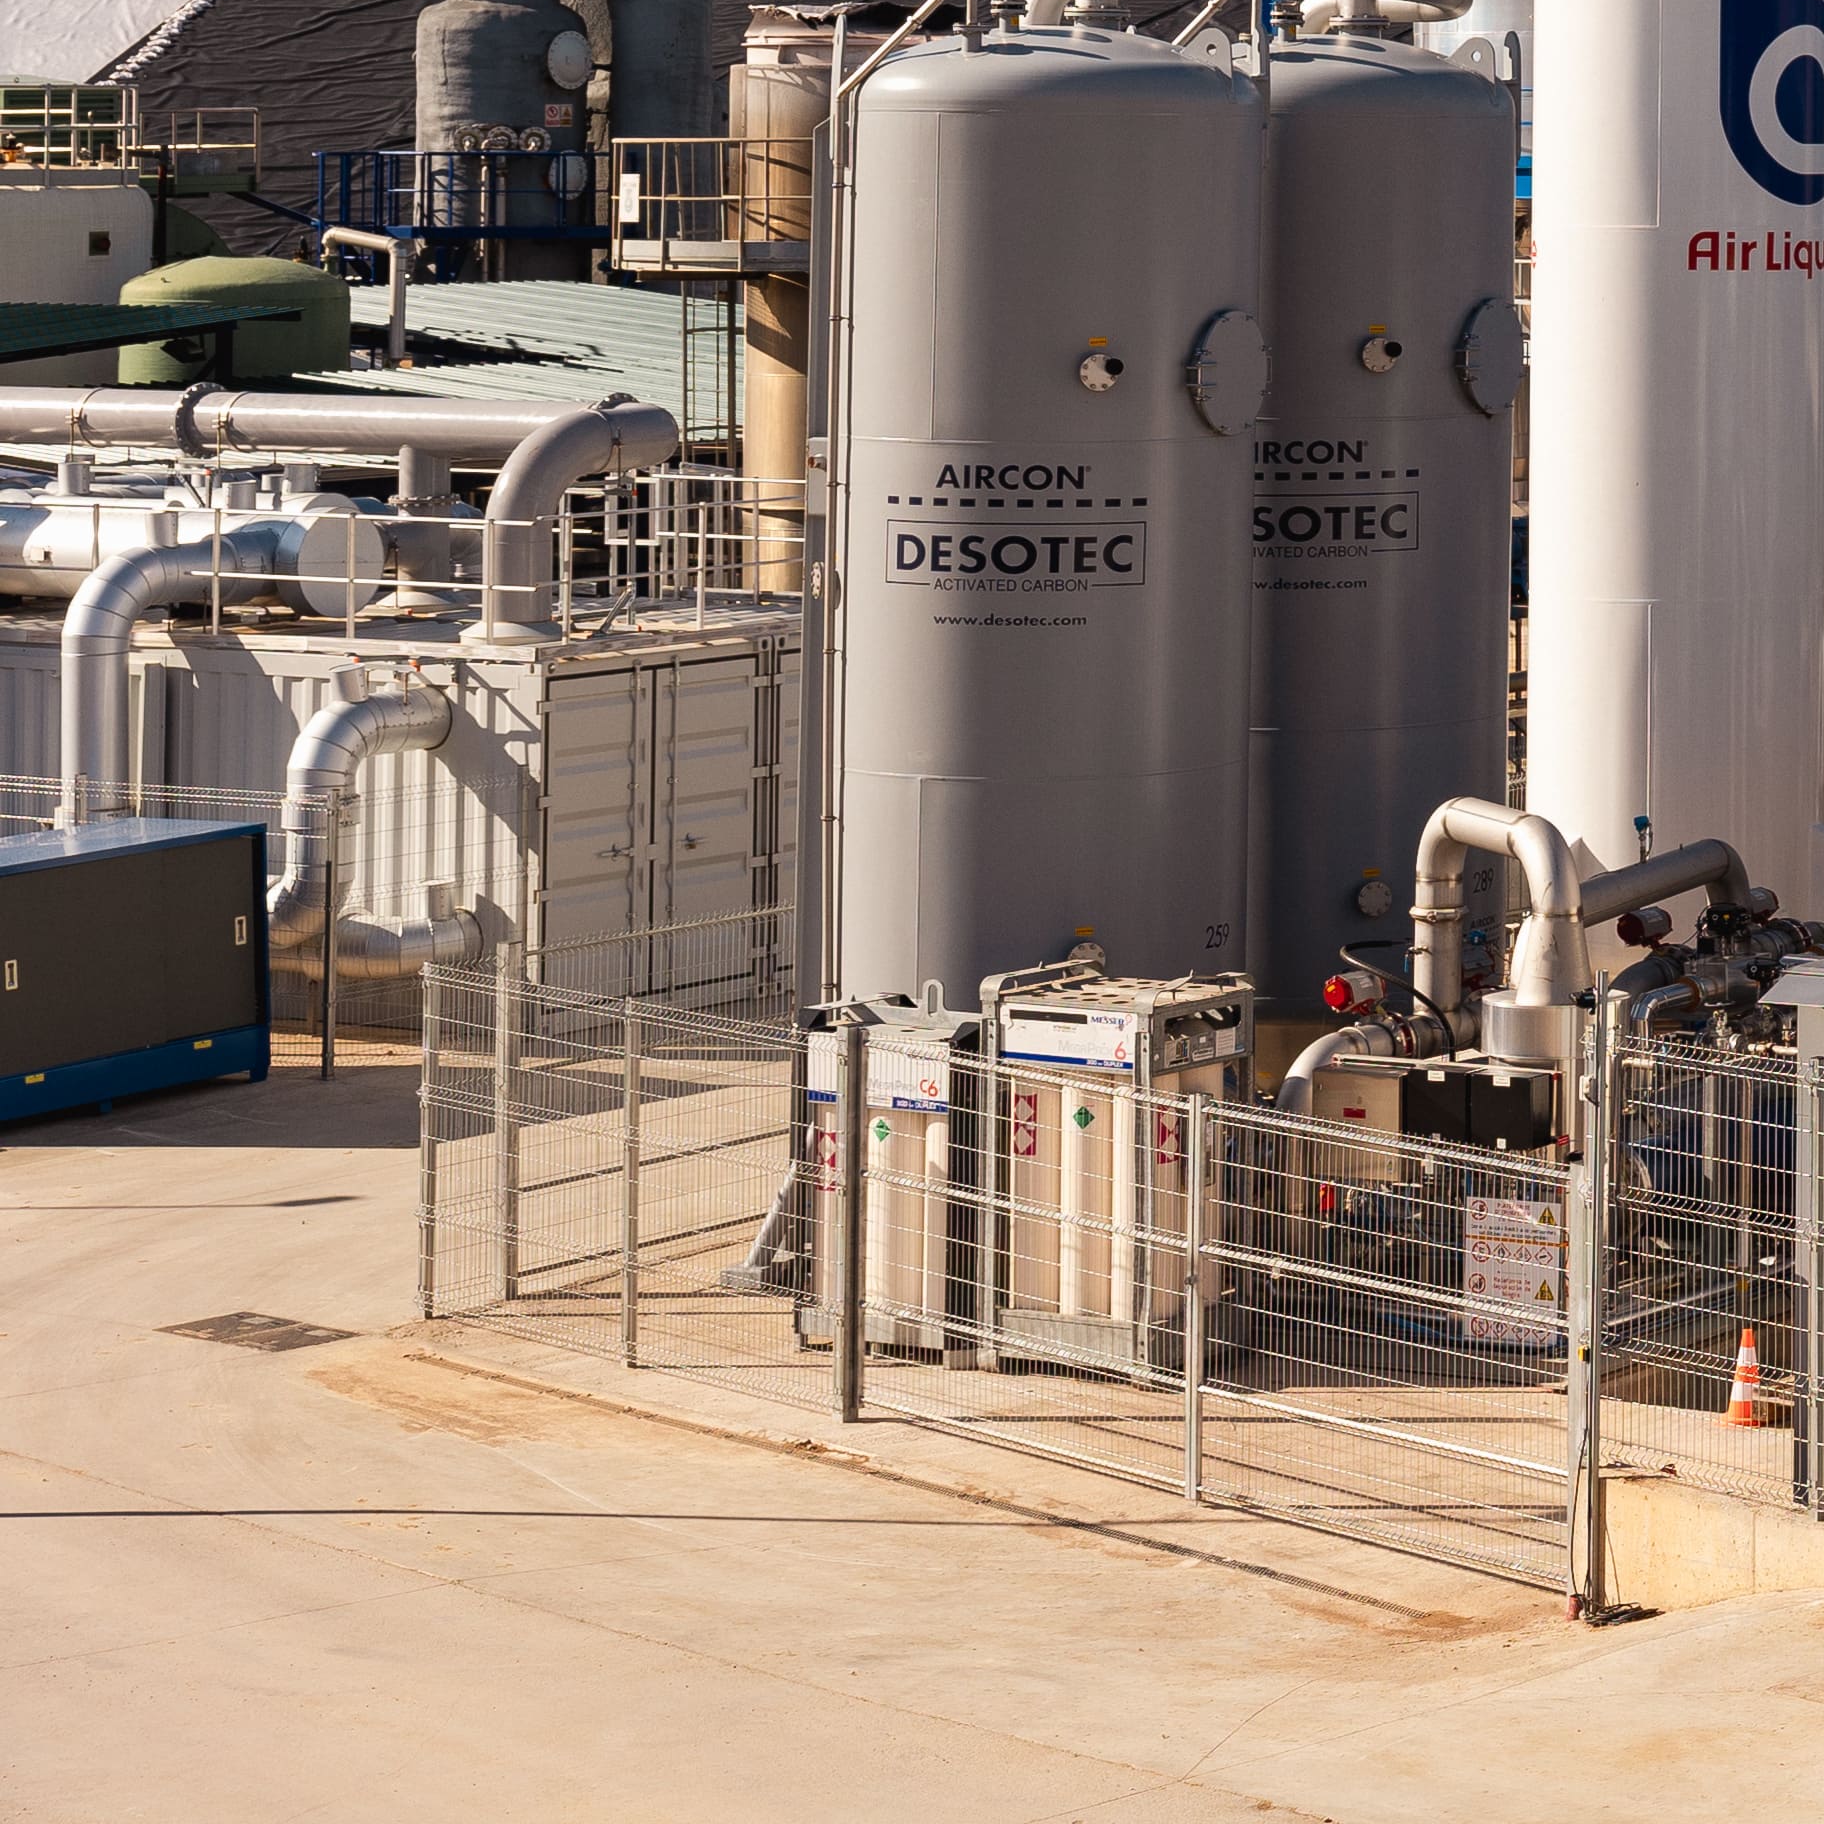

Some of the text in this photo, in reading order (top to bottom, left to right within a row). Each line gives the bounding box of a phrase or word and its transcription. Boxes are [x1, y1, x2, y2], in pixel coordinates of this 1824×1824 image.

[1687, 231, 1758, 271] Air
[1254, 440, 1364, 464] IRCON
[1253, 503, 1408, 542] SOTEC
[896, 533, 1134, 574] DESOTEC
[1253, 545, 1368, 558] IVATED CARBON
[933, 578, 1089, 592] ACTIVATED CARBON
[1254, 578, 1368, 590] w.desotec.com
[933, 613, 1087, 627] www.desotec.com
[1472, 867, 1494, 894] 289
[1205, 922, 1230, 949] 259
